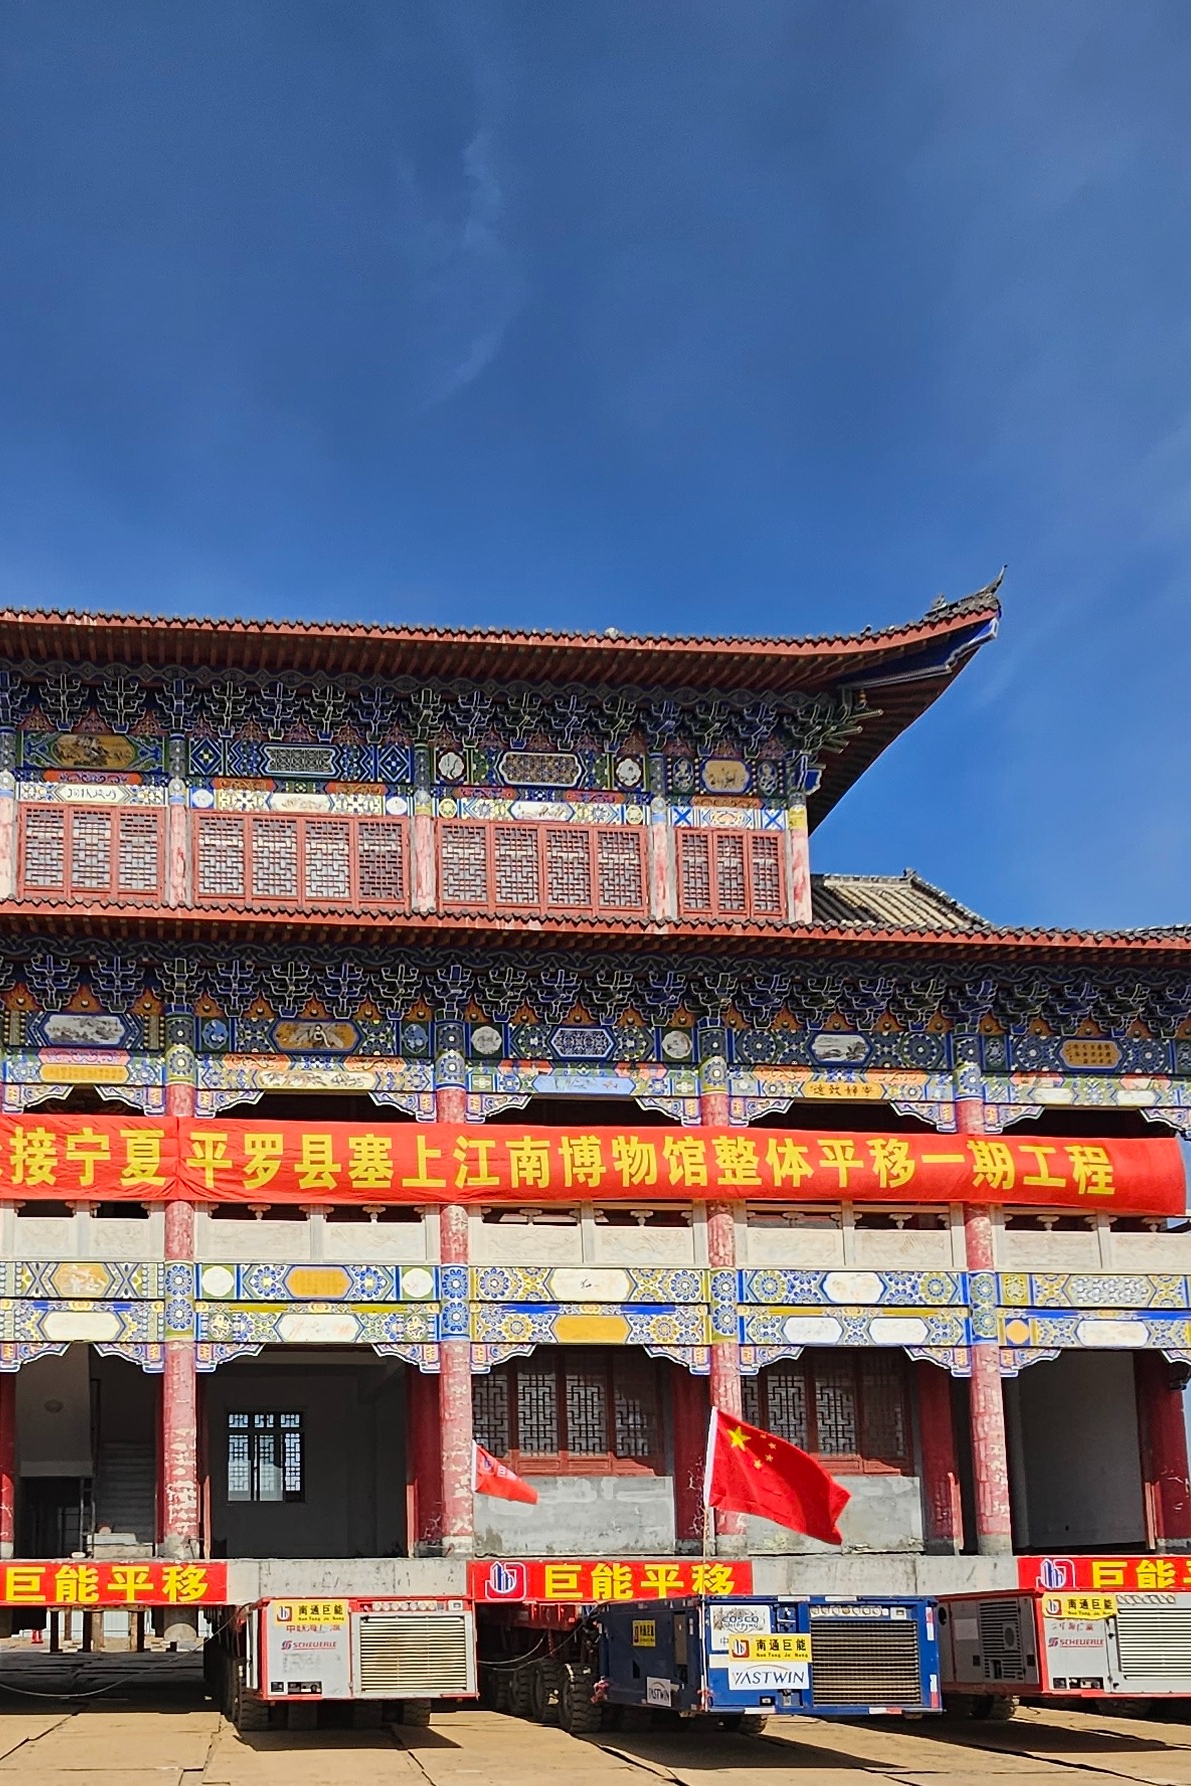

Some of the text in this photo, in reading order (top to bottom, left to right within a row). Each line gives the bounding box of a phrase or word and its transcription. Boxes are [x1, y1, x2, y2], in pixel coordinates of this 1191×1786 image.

[4, 1564, 208, 1603] 巨能平移
[544, 1560, 735, 1600] 巨能平移
[1092, 1560, 1191, 1588] 巨能
[298, 1604, 343, 1616] 南通巨能
[1067, 1599, 1113, 1610] 南通巨能
[756, 1639, 807, 1651] 南通巨能
